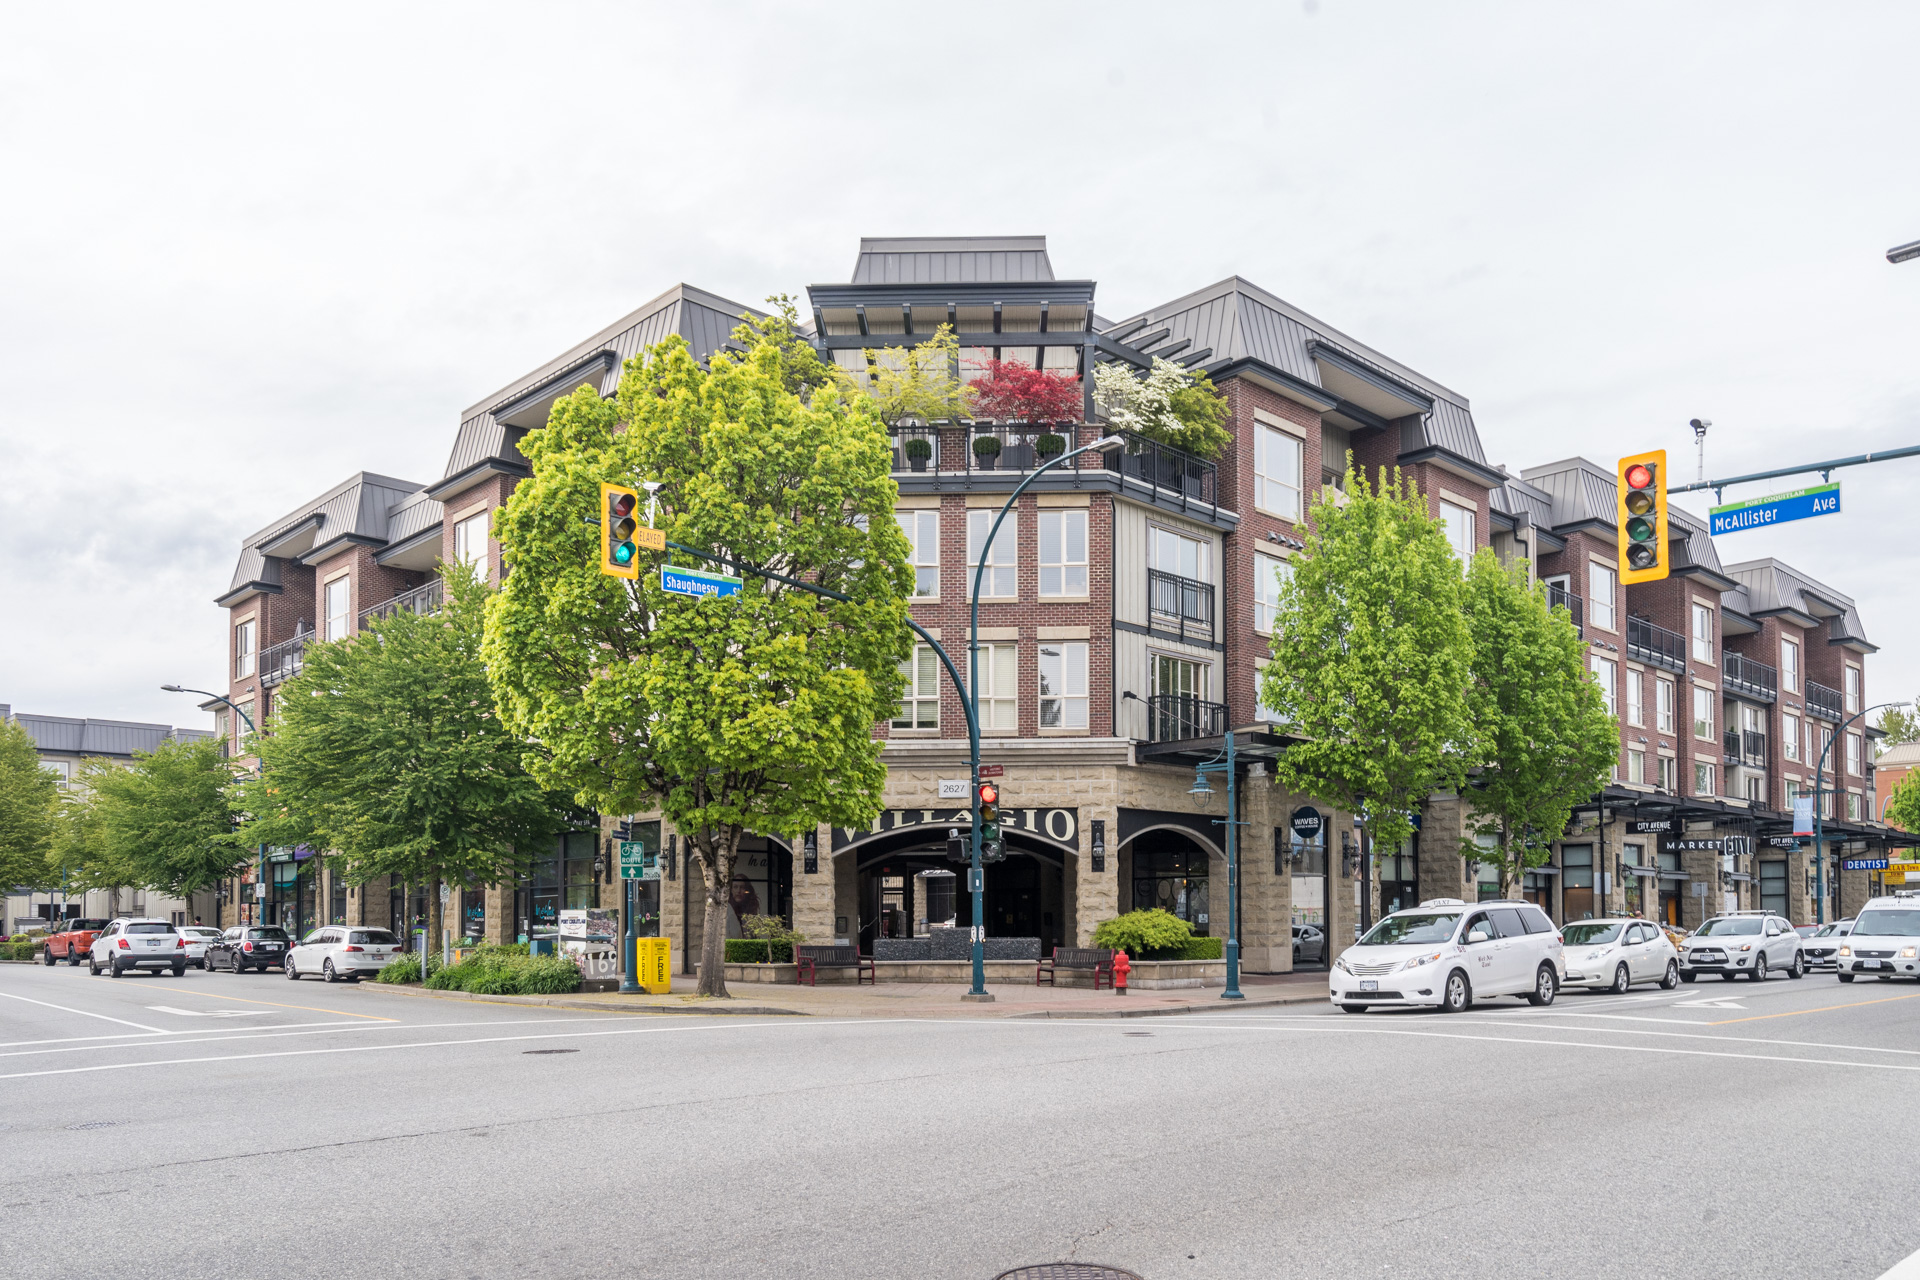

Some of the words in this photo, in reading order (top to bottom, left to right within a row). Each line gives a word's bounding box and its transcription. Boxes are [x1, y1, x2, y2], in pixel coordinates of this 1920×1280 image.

[1745, 498, 1762, 507] PORT
[1763, 489, 1805, 503] COQUITLAM
[1715, 508, 1778, 532] McAllister
[1812, 497, 1836, 513] Ave
[639, 530, 661, 545] ELAYED
[666, 575, 719, 595] Shaughnessy
[943, 784, 965, 793] 2627
[1294, 817, 1319, 826] WAVES
[1637, 822, 1649, 831] CITY
[1650, 820, 1671, 830] AVENUE
[1666, 841, 1722, 850] MARKET
[1770, 838, 1781, 846] CITY
[1781, 837, 1800, 845] AVE
[1847, 859, 1887, 869] DENTIST
